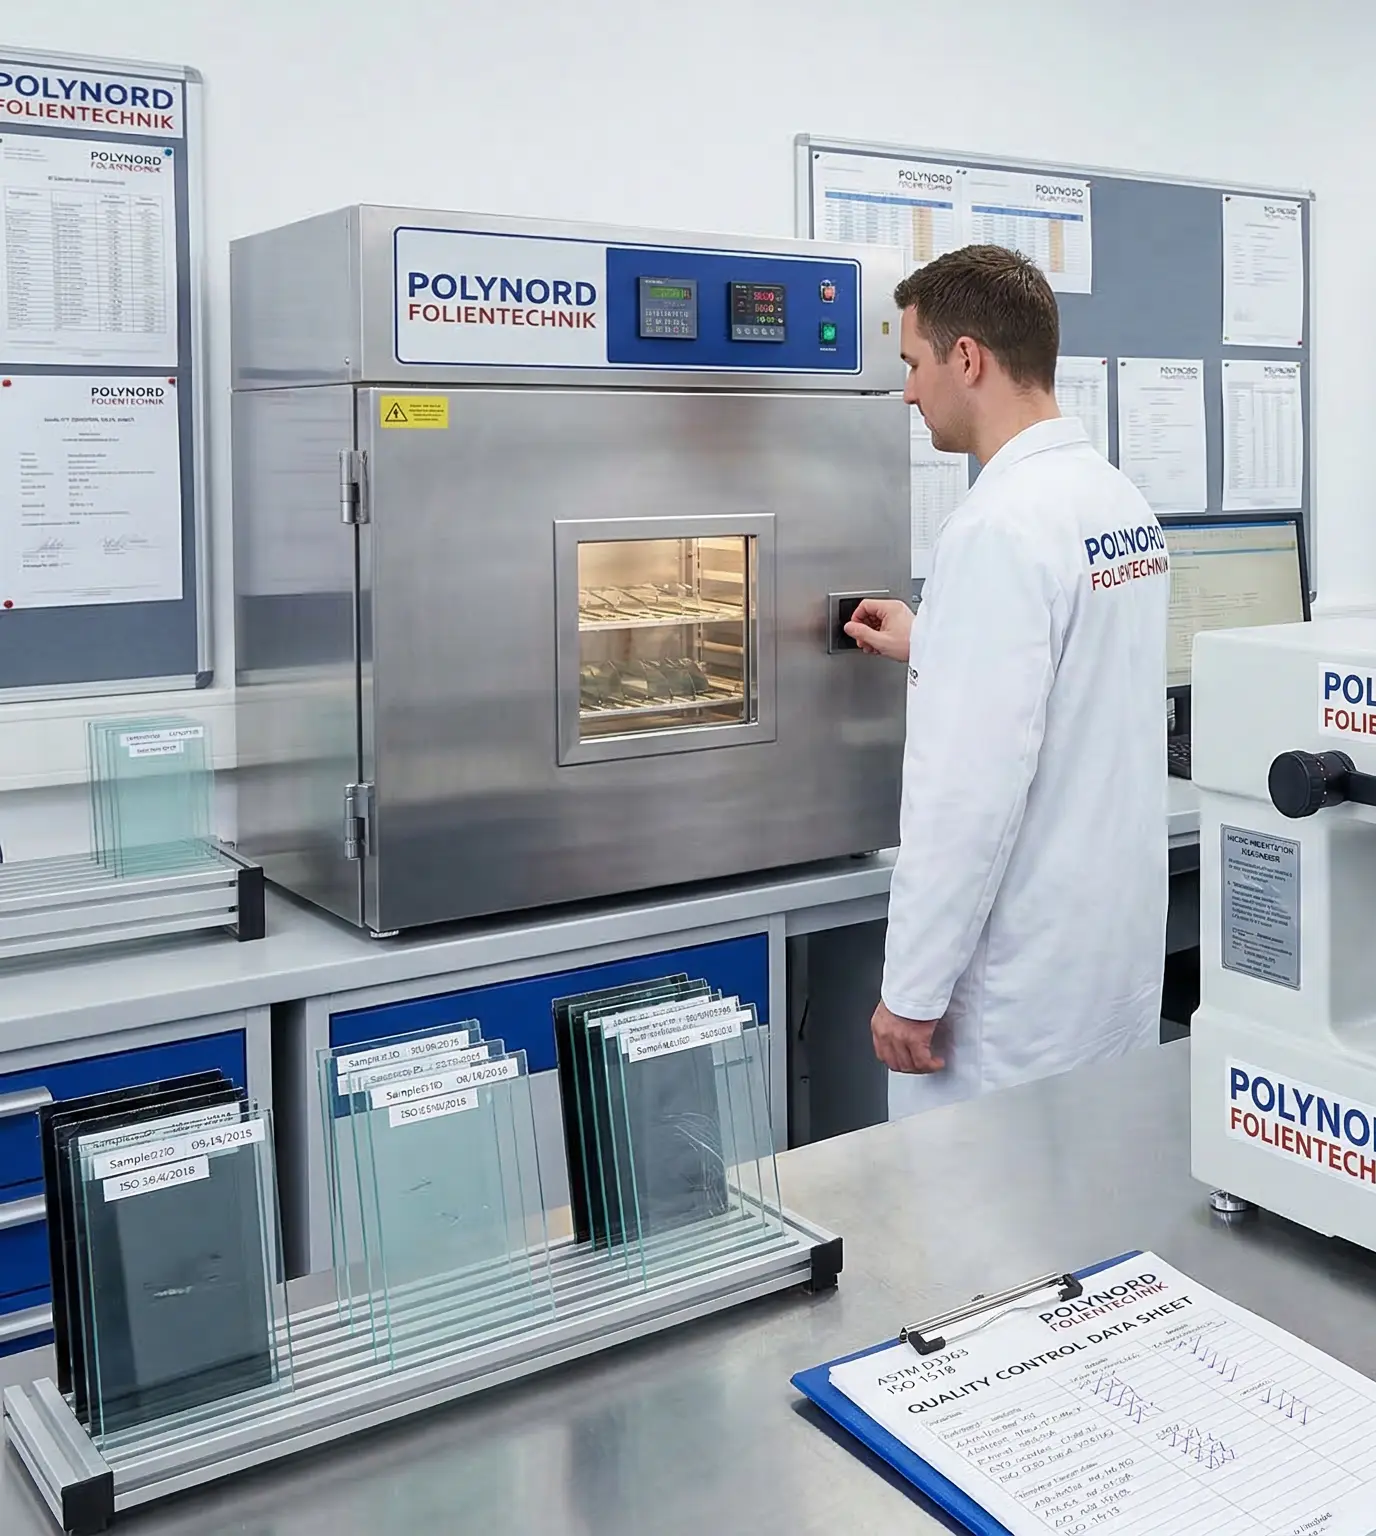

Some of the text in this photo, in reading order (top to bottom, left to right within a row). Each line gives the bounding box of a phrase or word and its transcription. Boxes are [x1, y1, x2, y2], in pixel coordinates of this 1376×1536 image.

[91, 151, 162, 166] POLYNORD
[898, 170, 953, 185] POLYNORD
[408, 271, 597, 306] POLYNORD
[408, 303, 597, 330] FOLIENTECHNIK
[91, 387, 165, 397] POLYNORD
[1038, 1273, 1157, 1324] POLYNORD
[908, 1376, 991, 1414] QUALITY
[995, 1340, 1085, 1381] CONTROL
[1086, 1321, 1138, 1344] DATA
[1136, 1295, 1195, 1324] SHEET
[877, 1365, 920, 1386] ASTM
[886, 1365, 956, 1395] ISO 1518
